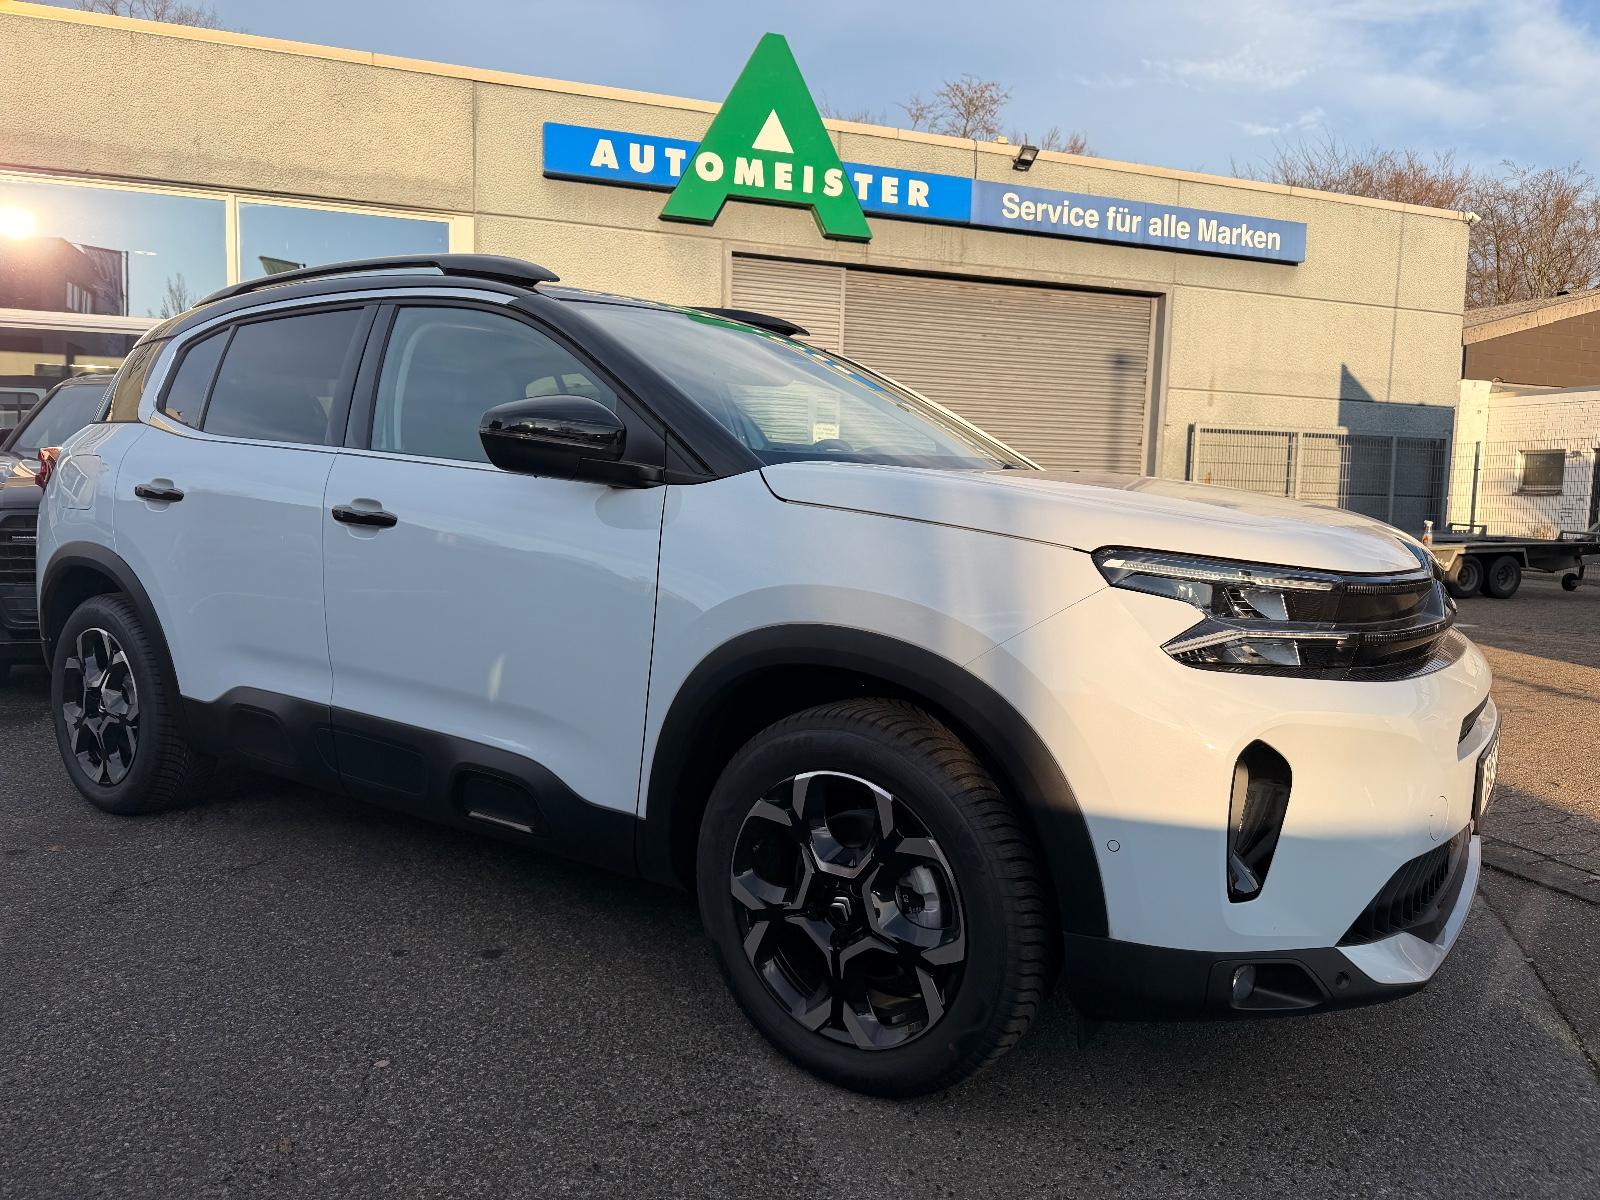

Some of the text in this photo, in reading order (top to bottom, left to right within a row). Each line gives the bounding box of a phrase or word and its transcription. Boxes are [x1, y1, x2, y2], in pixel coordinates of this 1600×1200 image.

[590, 139, 930, 208] AUTOMEISTER
[1001, 192, 1281, 251] Service für alle Marken
